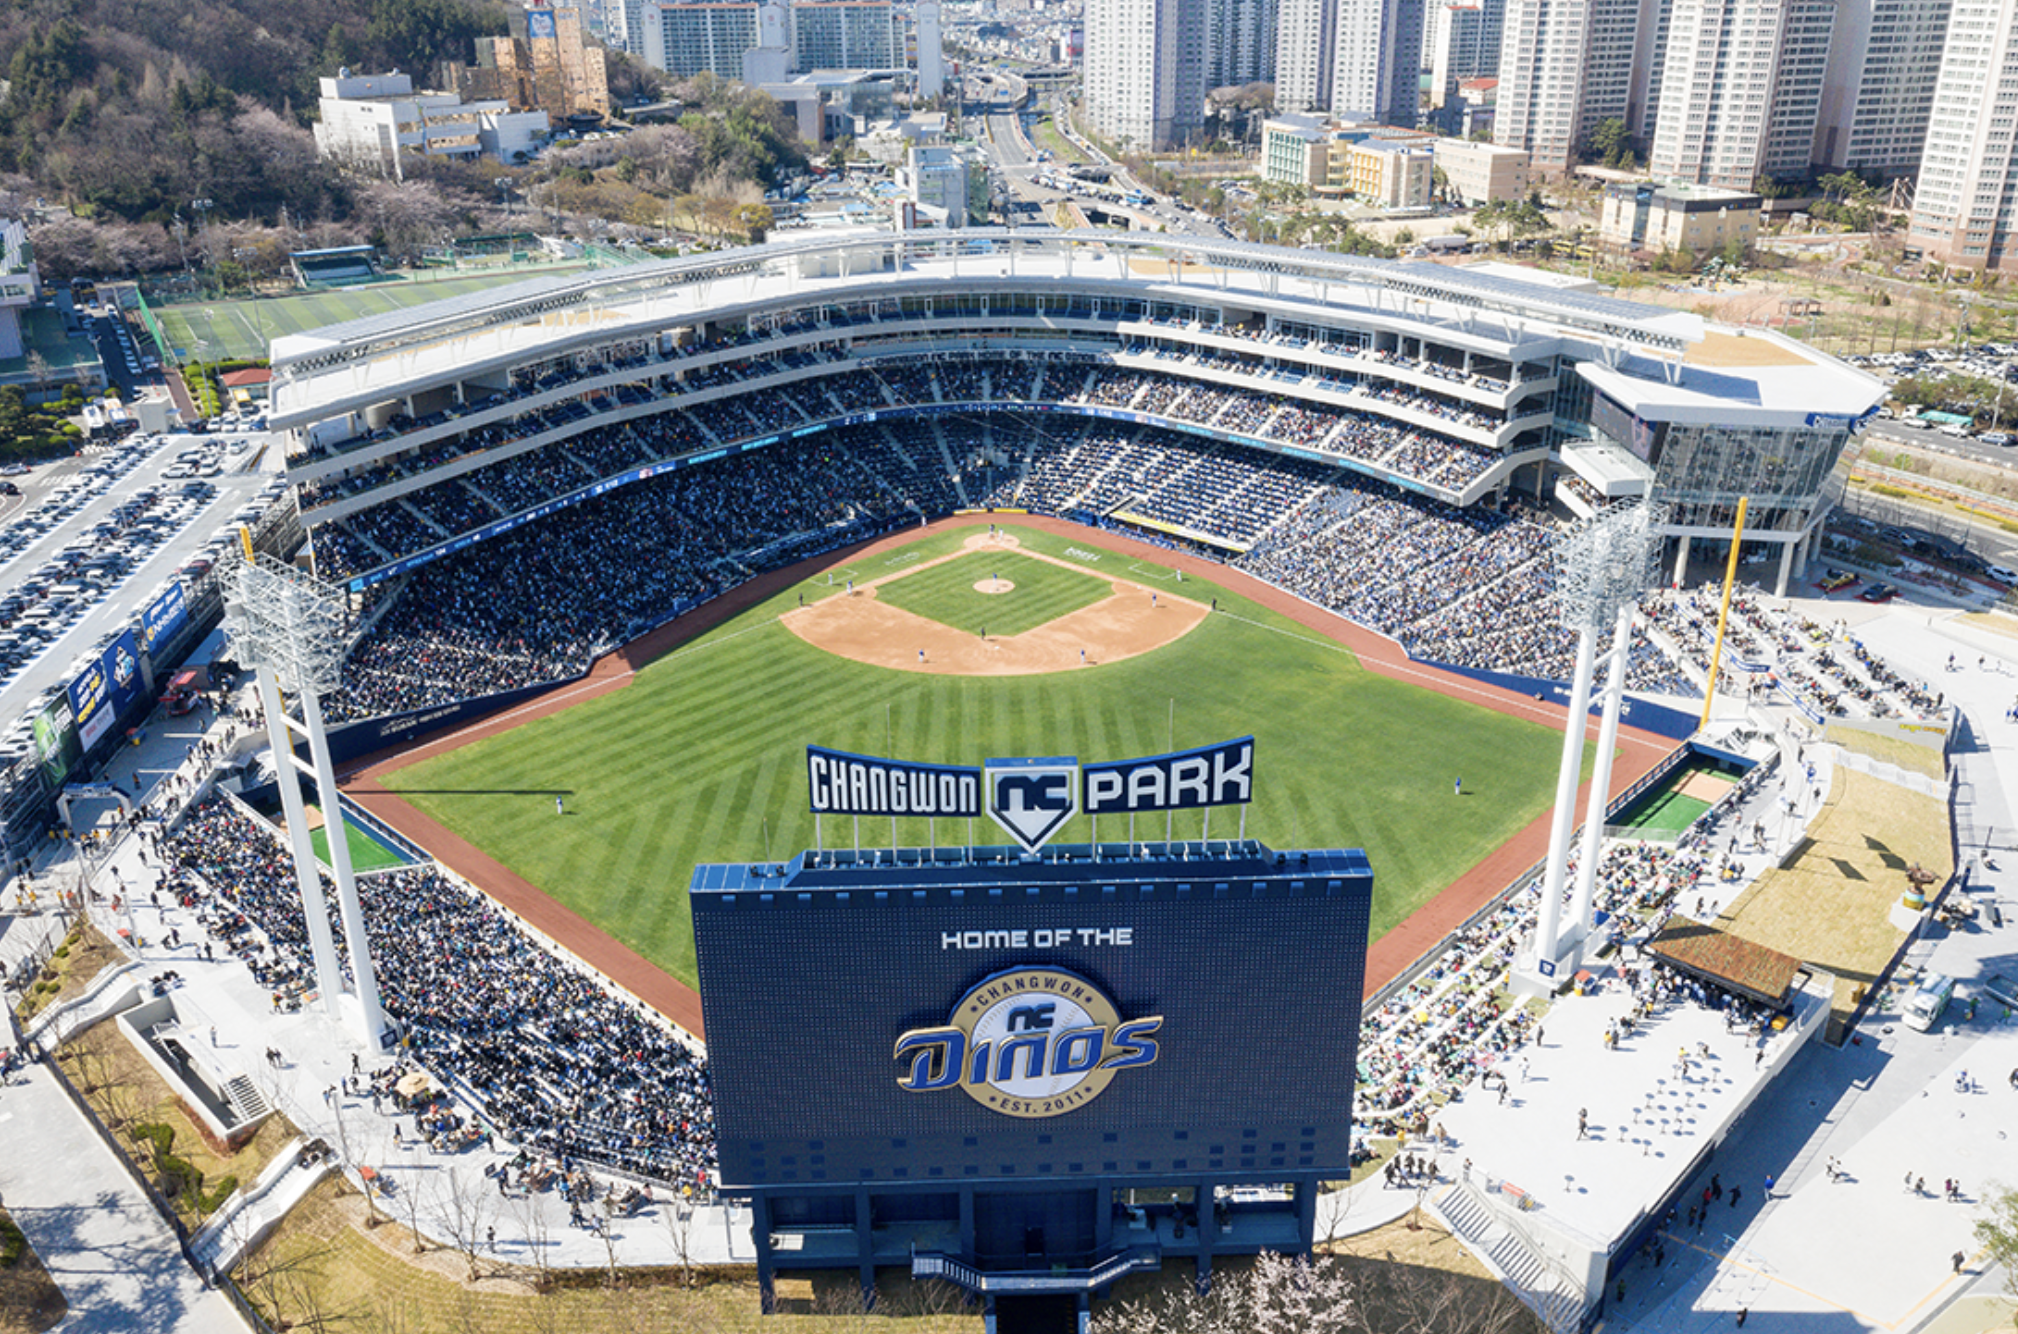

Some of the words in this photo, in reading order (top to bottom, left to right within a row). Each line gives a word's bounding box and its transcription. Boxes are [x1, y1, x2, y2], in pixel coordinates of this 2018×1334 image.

[810, 754, 976, 813] CHANGWON
[997, 775, 1067, 811] NC
[1088, 744, 1252, 810] PARK
[941, 929, 1028, 950] HOME
[1034, 928, 1072, 949] OF
[1077, 927, 1133, 947] THE
[976, 975, 1085, 1006] CHANGWON
[1007, 1002, 1056, 1032] NC
[1000, 1098, 1038, 1114] EST.
[1043, 1090, 1084, 1113] 2011
